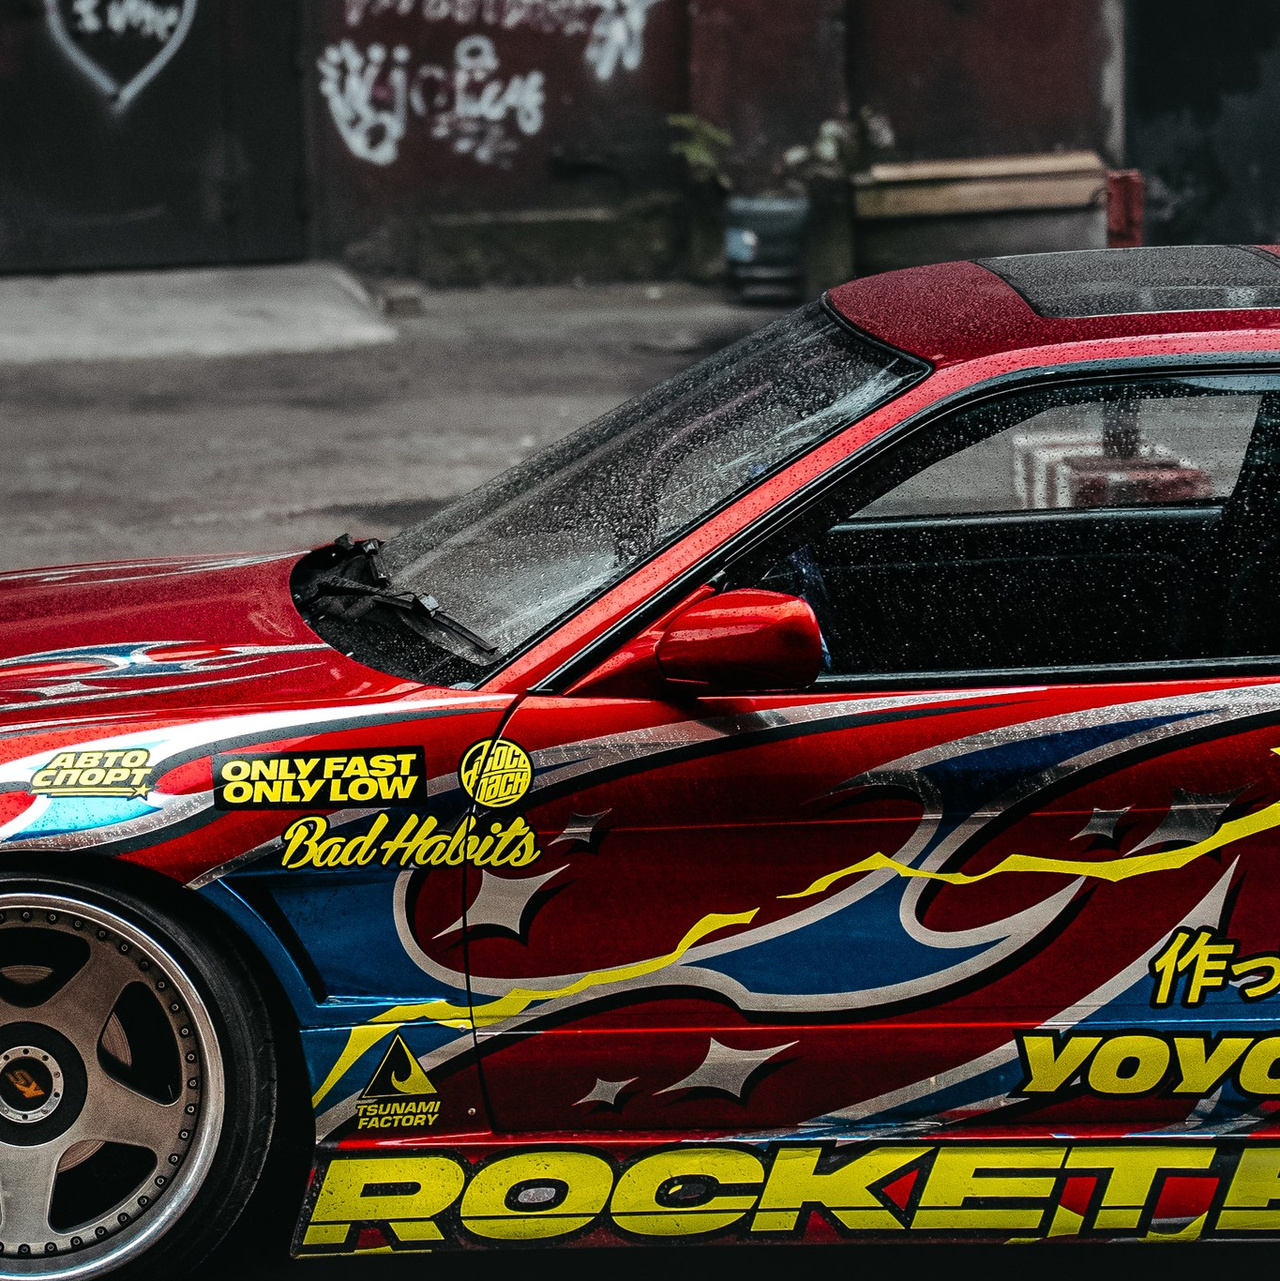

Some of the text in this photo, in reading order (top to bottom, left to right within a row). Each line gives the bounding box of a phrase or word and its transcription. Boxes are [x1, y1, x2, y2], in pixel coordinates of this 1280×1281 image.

[47, 749, 149, 769] АВТО
[221, 753, 418, 781] ONLY FAST
[31, 767, 153, 787] СПОРТ
[223, 776, 419, 803] ONLY LOW
[281, 812, 542, 869] Bad Habits
[357, 1101, 441, 1117] TSUNAMI
[357, 1113, 440, 1130] FACTORY
